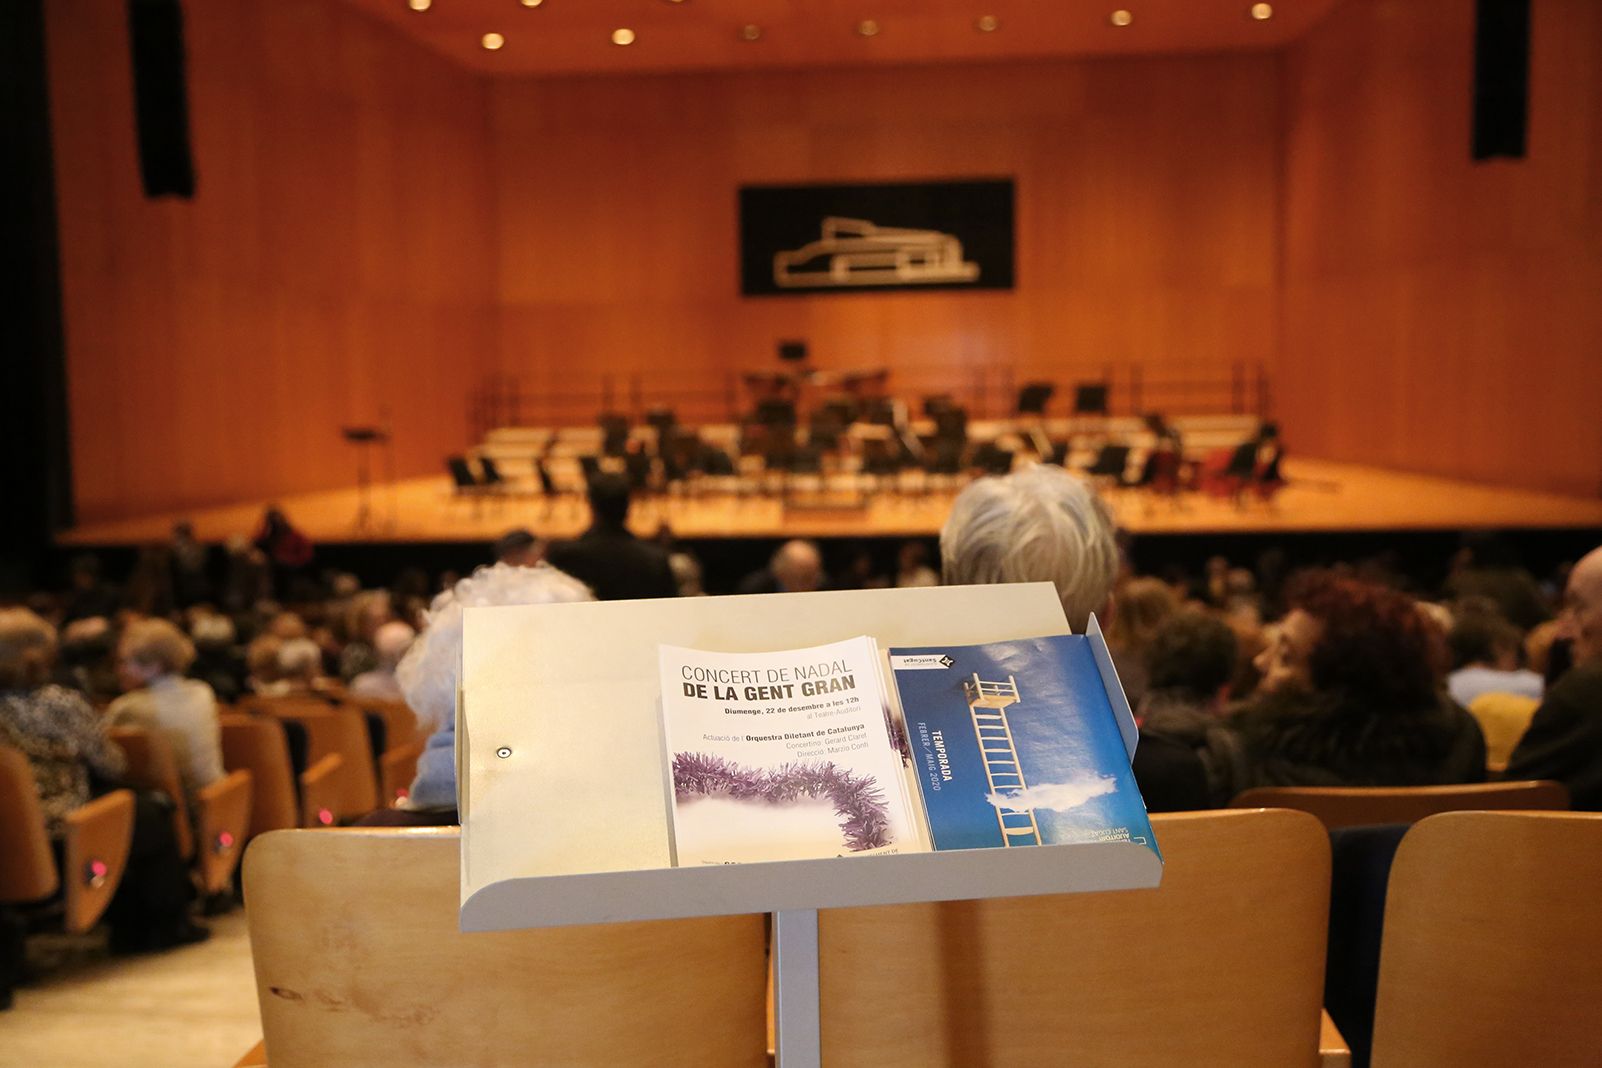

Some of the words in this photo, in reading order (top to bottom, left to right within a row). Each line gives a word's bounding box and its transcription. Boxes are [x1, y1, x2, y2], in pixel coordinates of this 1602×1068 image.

[682, 665, 760, 684] CONCERT
[767, 668, 790, 683] DE
[794, 659, 853, 680] NADAL
[683, 682, 708, 699] DE
[714, 686, 738, 700] LA
[744, 684, 794, 701] GENT
[801, 675, 855, 697] GRAN
[788, 704, 824, 712] desembre
[703, 733, 730, 741] Actuació
[784, 731, 814, 740] Diletant
[827, 723, 865, 735] Catalunya
[824, 735, 847, 745] Gerard
[848, 732, 867, 742] Claret
[827, 745, 850, 754] Marzio
[851, 741, 869, 751] Conti
[931, 730, 953, 781] TEMPORADA
[930, 772, 941, 791] 2020
